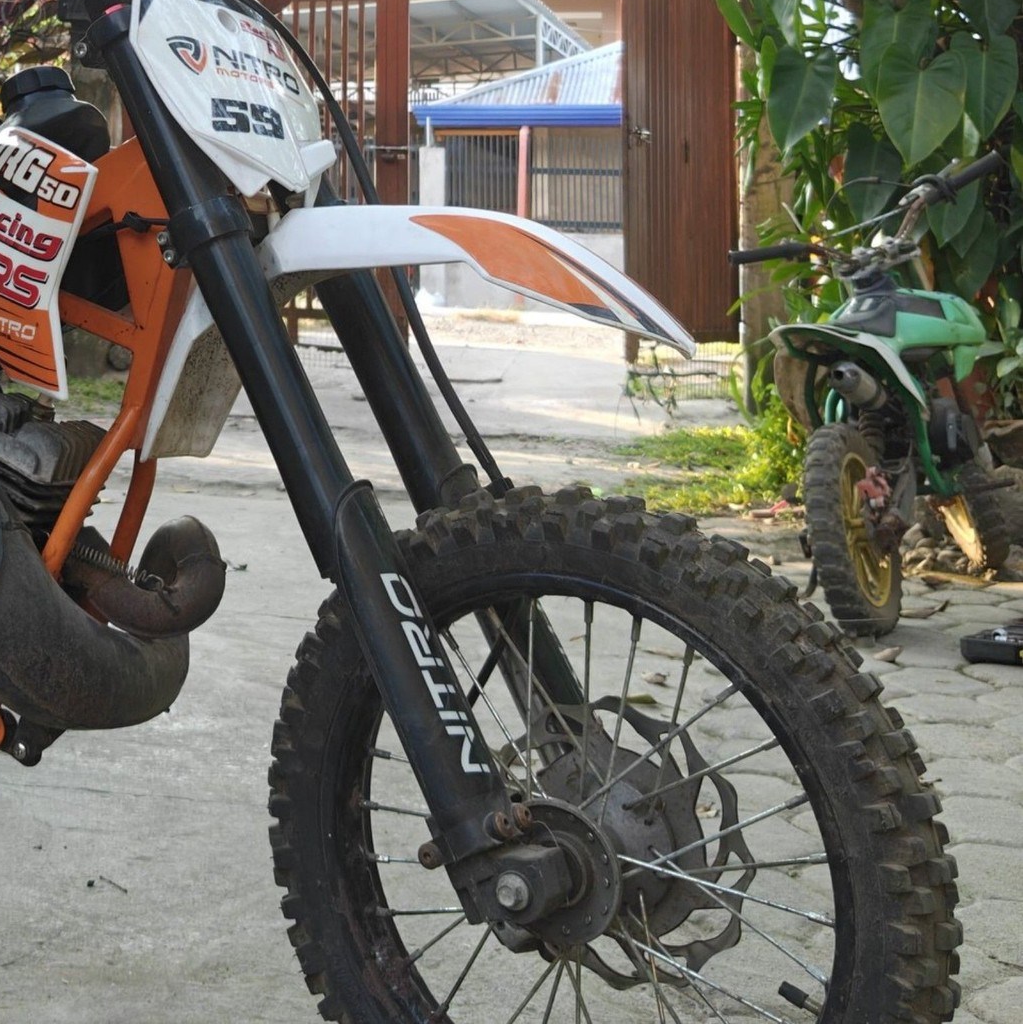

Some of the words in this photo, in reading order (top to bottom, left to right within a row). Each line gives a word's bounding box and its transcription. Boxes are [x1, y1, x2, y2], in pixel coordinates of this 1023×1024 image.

[212, 45, 300, 95] NITRO
[211, 97, 285, 140] 59
[37, 175, 80, 209] 50
[380, 573, 490, 773] NITRO
